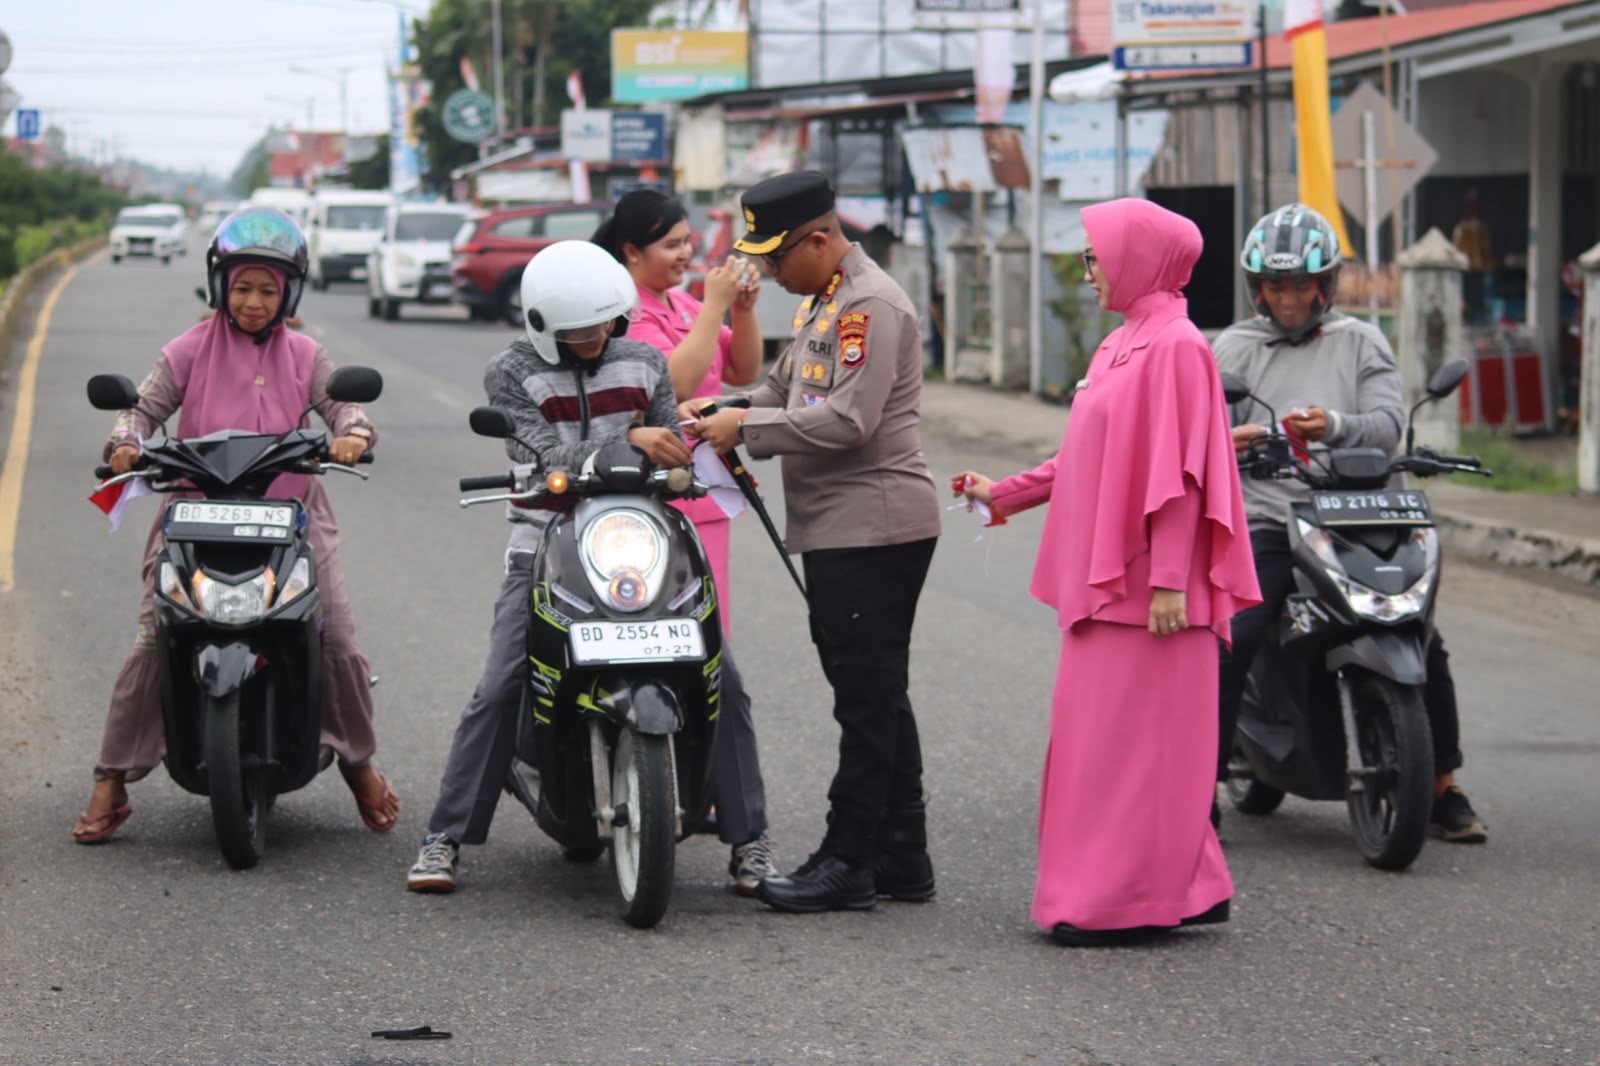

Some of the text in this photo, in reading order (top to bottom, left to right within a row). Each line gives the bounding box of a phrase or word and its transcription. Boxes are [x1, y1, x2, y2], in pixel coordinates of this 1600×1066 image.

[1319, 495, 1343, 510] BD
[1395, 494, 1419, 508] TC
[180, 505, 286, 522] BD 5269 NS
[580, 626, 604, 642] BD
[615, 625, 660, 641] 2554
[643, 644, 692, 656] 07-27
